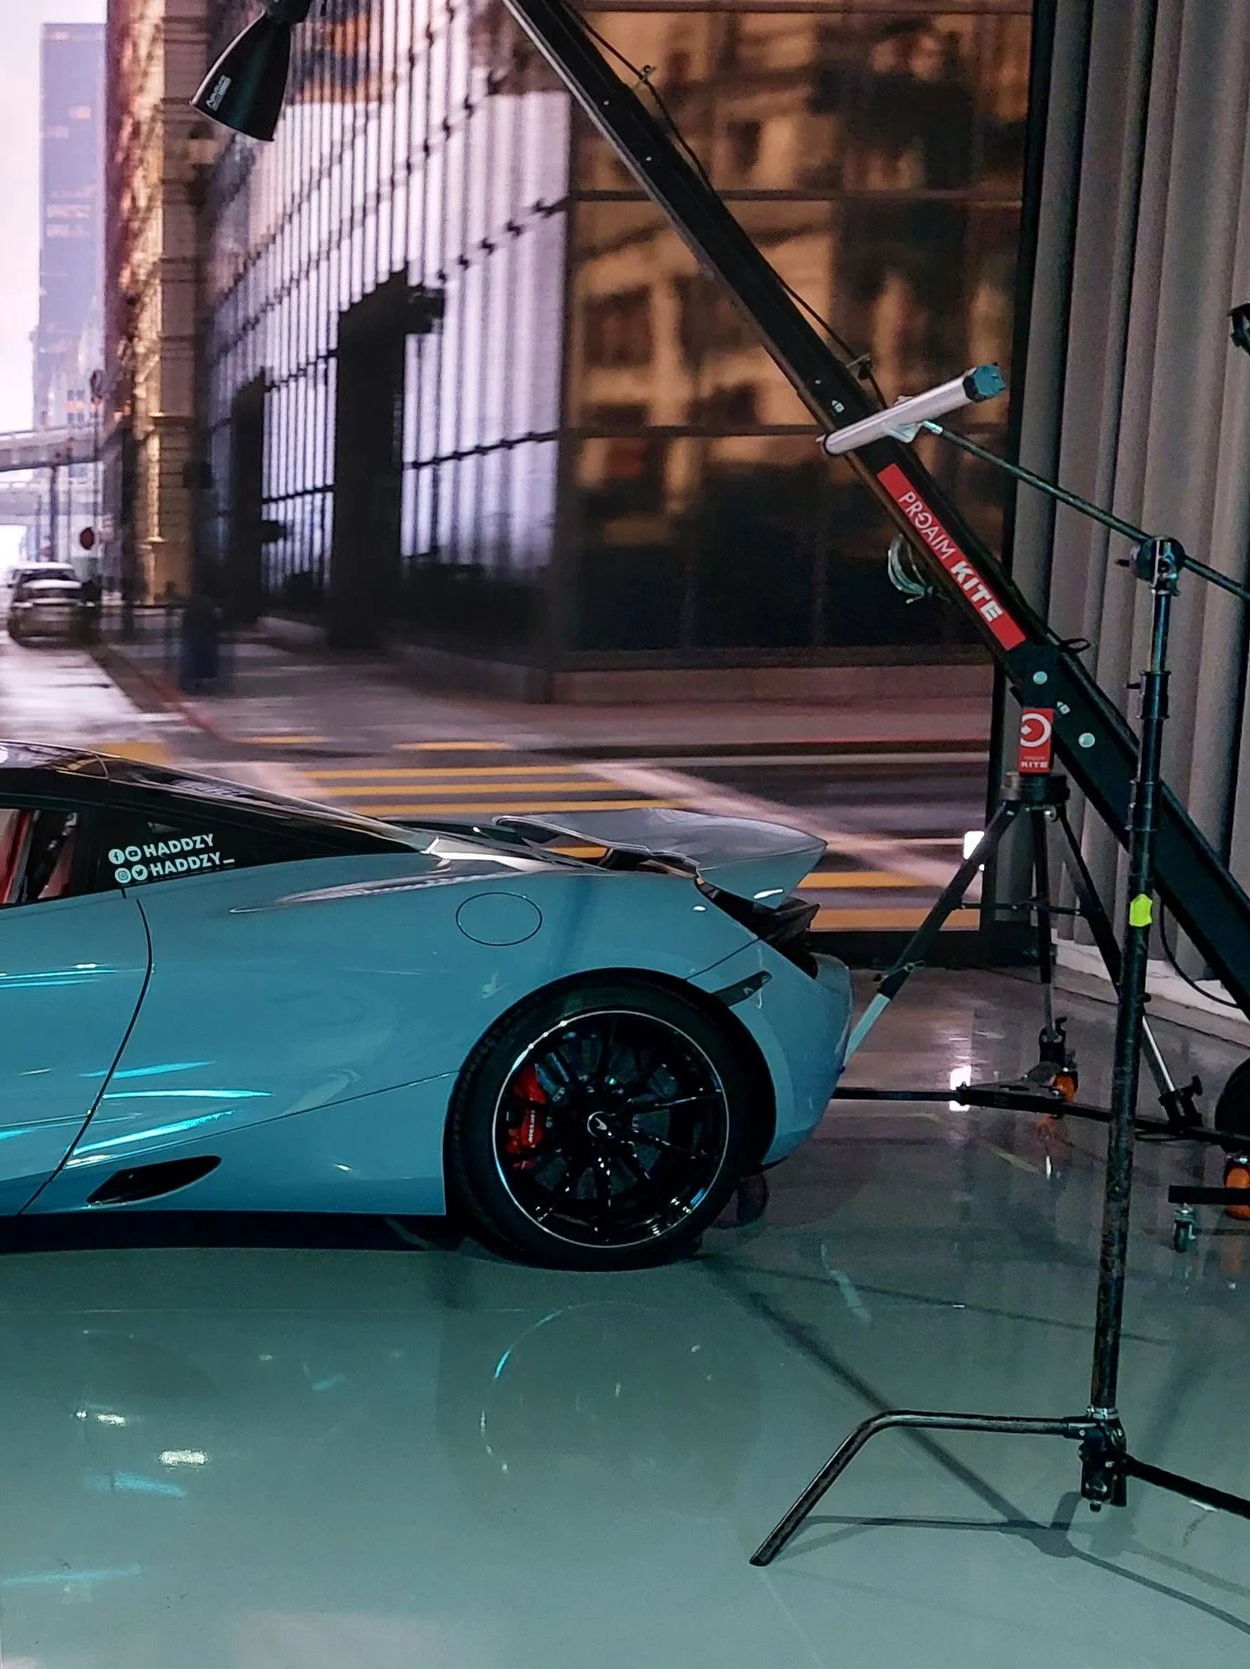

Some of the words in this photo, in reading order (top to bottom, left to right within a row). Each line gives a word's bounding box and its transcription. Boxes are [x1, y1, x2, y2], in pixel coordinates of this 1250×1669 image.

[899, 491, 956, 558] PROAIM
[950, 561, 1003, 622] KITE
[143, 834, 213, 857] HADDZY
[150, 852, 235, 876] HADDZY_
